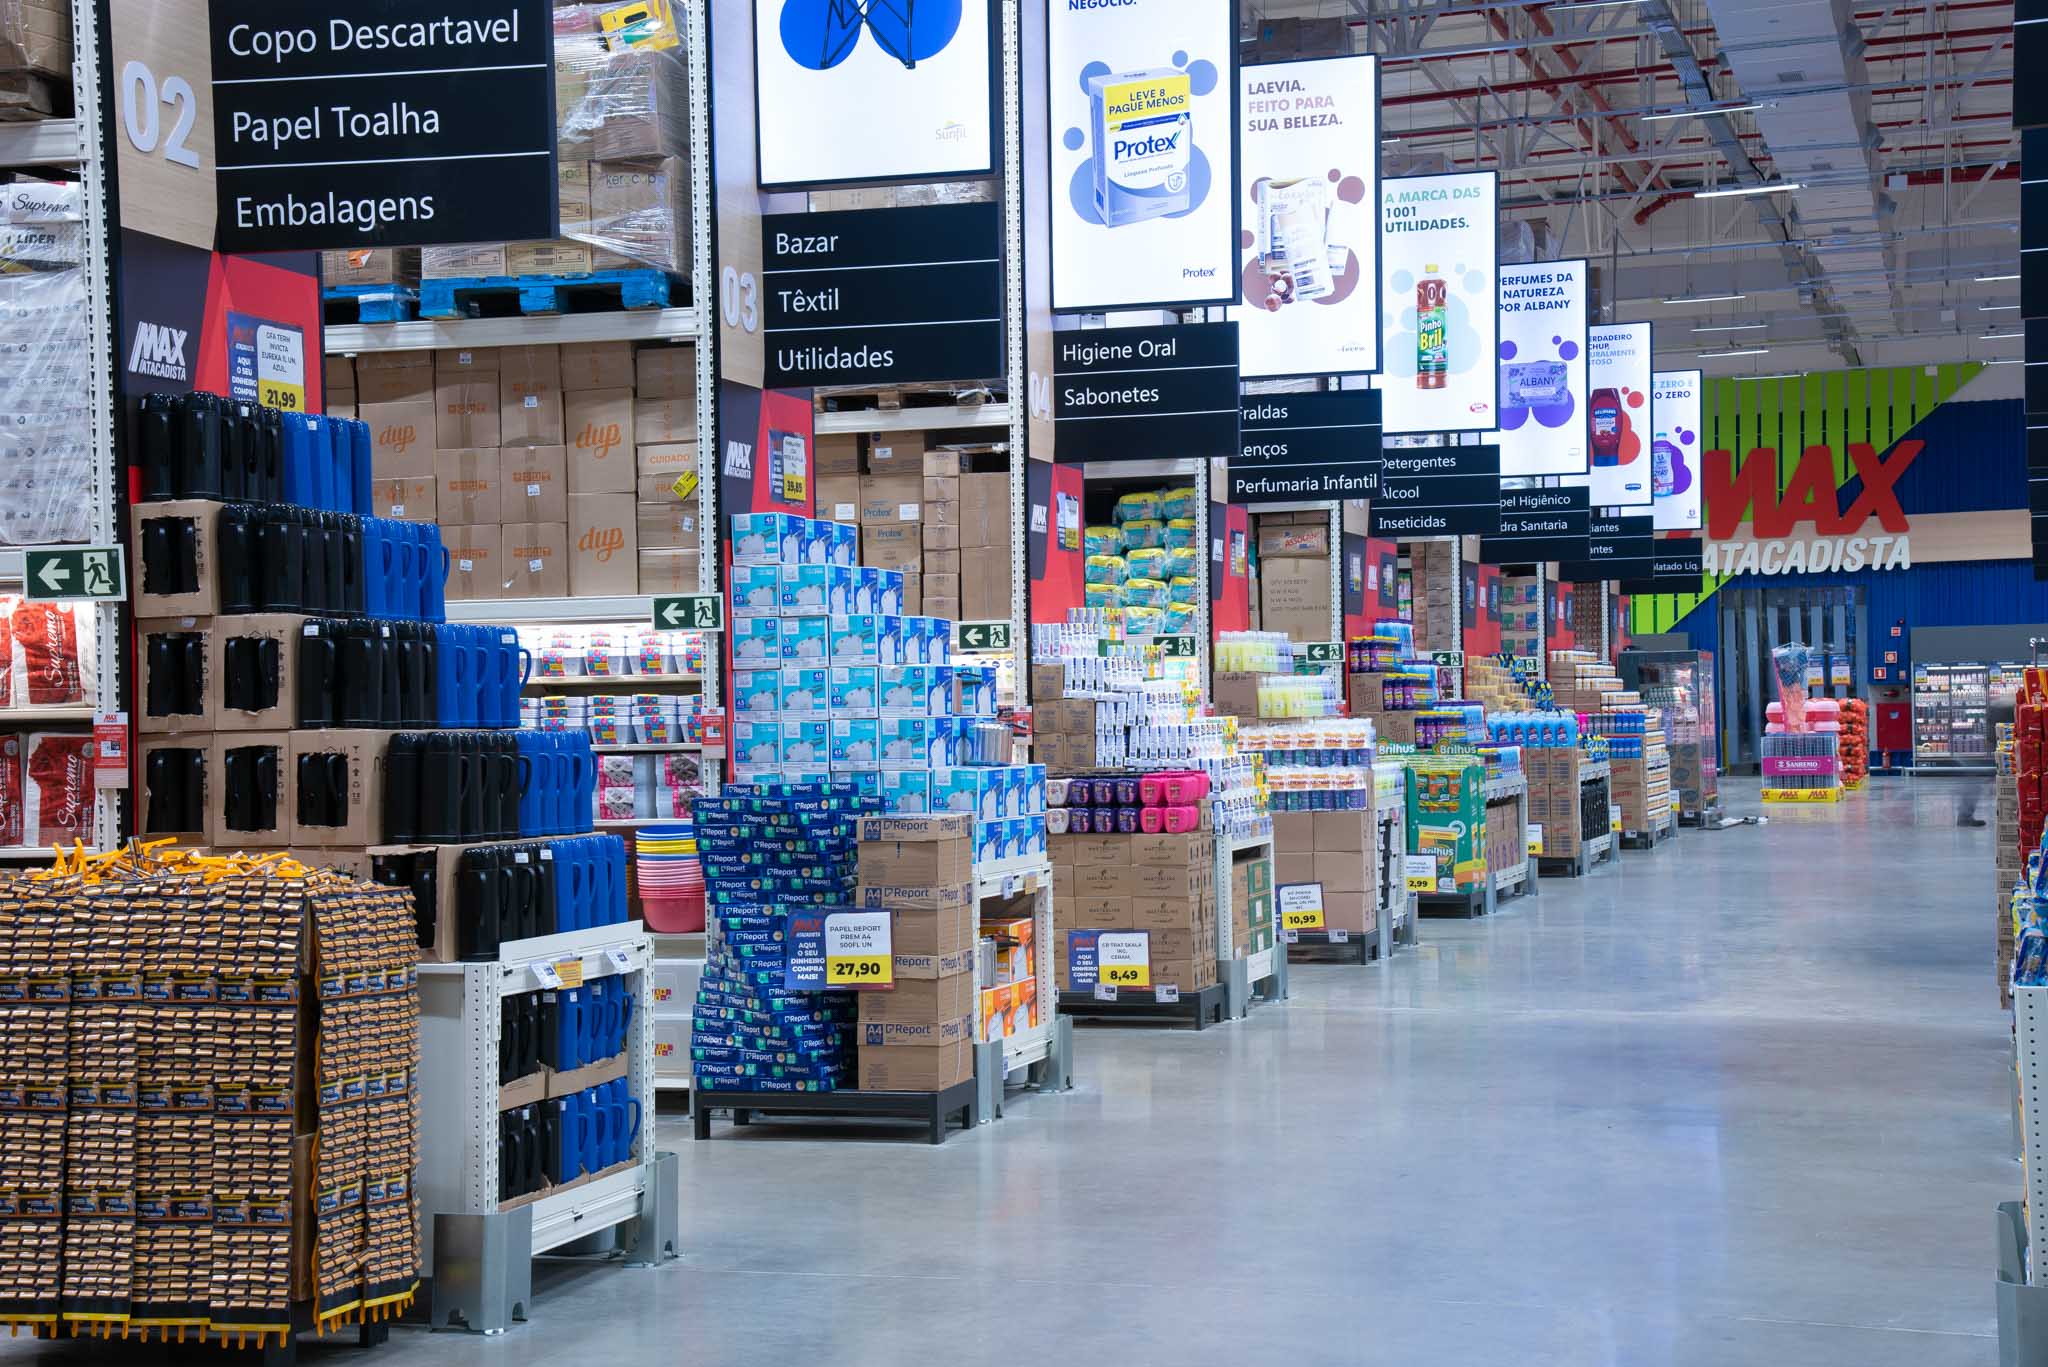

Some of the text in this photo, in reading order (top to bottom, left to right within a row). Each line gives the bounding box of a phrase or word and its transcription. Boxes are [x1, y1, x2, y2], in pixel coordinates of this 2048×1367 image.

[228, 9, 519, 63] Copo Descartavel
[1248, 80, 1305, 95] LAEVIA.
[1130, 88, 1166, 102] LEVE 8
[1109, 95, 1184, 115] PAGUE MENOS
[1248, 96, 1335, 113] FEITO PARA
[122, 60, 199, 170] 02
[233, 101, 440, 150] Papel Toalha
[1248, 114, 1343, 132] SUA BELEZA.
[1114, 131, 1181, 160] Protex
[1385, 187, 1481, 203] A MARCA DAS
[237, 191, 434, 231] Embalagens
[1386, 206, 1416, 218] 1001
[1385, 217, 1469, 233] UTILIDADES.
[776, 233, 839, 255] Bazar
[1182, 267, 1216, 278] Protex
[1500, 273, 1574, 286] ERFUMES DA
[722, 265, 758, 333] 03
[1503, 286, 1564, 299] NATUREZA
[778, 288, 839, 313] Têxtil
[1524, 300, 1570, 311] ALBANY
[1420, 319, 1442, 332] Pinho
[1420, 328, 1442, 351] Bril
[128, 321, 187, 373] MAX
[1063, 338, 1176, 366] Higiene Oral
[778, 345, 894, 372] Utilidades
[138, 359, 187, 382] ATACADISTA
[1520, 377, 1556, 386] ALBANY
[1660, 380, 1685, 388] ZERO
[267, 389, 296, 410] 21,99
[1064, 387, 1160, 406] Sabonetes
[1665, 391, 1691, 399] ZERO
[576, 423, 622, 459] dup
[724, 440, 752, 476] MAX
[1240, 444, 1288, 459] enços
[1236, 473, 1377, 493] Perfumaria Infantil
[1703, 439, 1926, 540] MAX
[1519, 494, 1571, 508] Higiênico
[1379, 515, 1447, 529] Inseticidas
[578, 527, 624, 562] dup
[1703, 535, 1911, 576] ATACADISTA
[44, 609, 64, 688] Supremo
[1378, 744, 1415, 754] Brilhus
[1440, 745, 1476, 754] Brilhus
[58, 754, 78, 832] Supremo
[734, 787, 750, 795] Report
[800, 802, 818, 810] Report
[748, 816, 767, 824] Report
[865, 820, 928, 832] A4 Report
[760, 842, 781, 850] Report
[714, 855, 736, 863] Report
[774, 868, 796, 877] Report
[722, 881, 746, 889] Report
[1409, 880, 1428, 888] 2,99
[866, 888, 928, 899] A4 Report
[732, 907, 757, 915] Report
[1289, 915, 1316, 925] 10,99
[743, 933, 768, 941] Report
[758, 960, 783, 968] Report
[896, 957, 930, 967] Report
[836, 963, 881, 978] 27,90
[1110, 970, 1138, 982] 8,49
[896, 1024, 931, 1036] Report
[752, 1053, 772, 1061] Report
[708, 1065, 730, 1073] Report
[768, 1081, 791, 1089] Report
